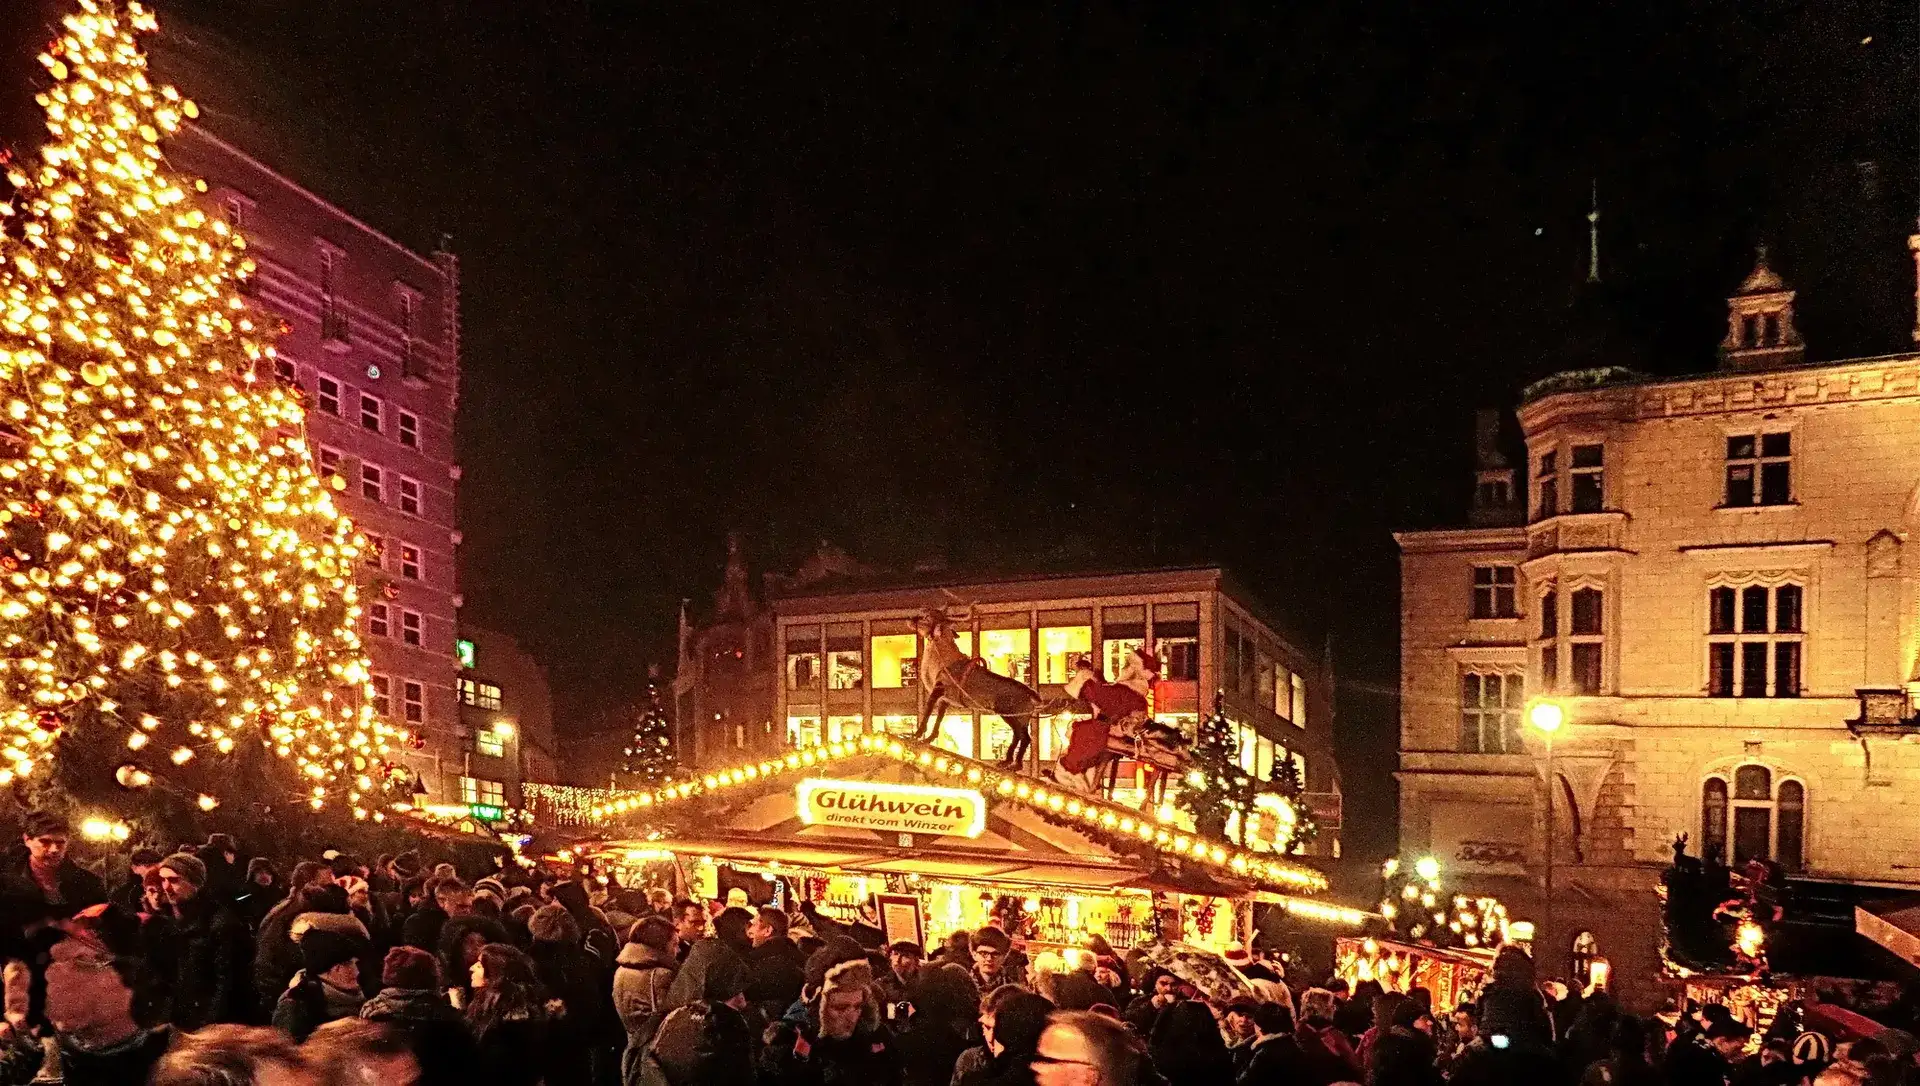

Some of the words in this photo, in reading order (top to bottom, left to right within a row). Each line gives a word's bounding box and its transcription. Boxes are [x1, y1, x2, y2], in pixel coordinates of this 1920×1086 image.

[816, 790, 966, 819] Glühwein
[826, 813, 865, 824] direkt
[869, 817, 898, 827] vom
[904, 819, 954, 831] Winzer
